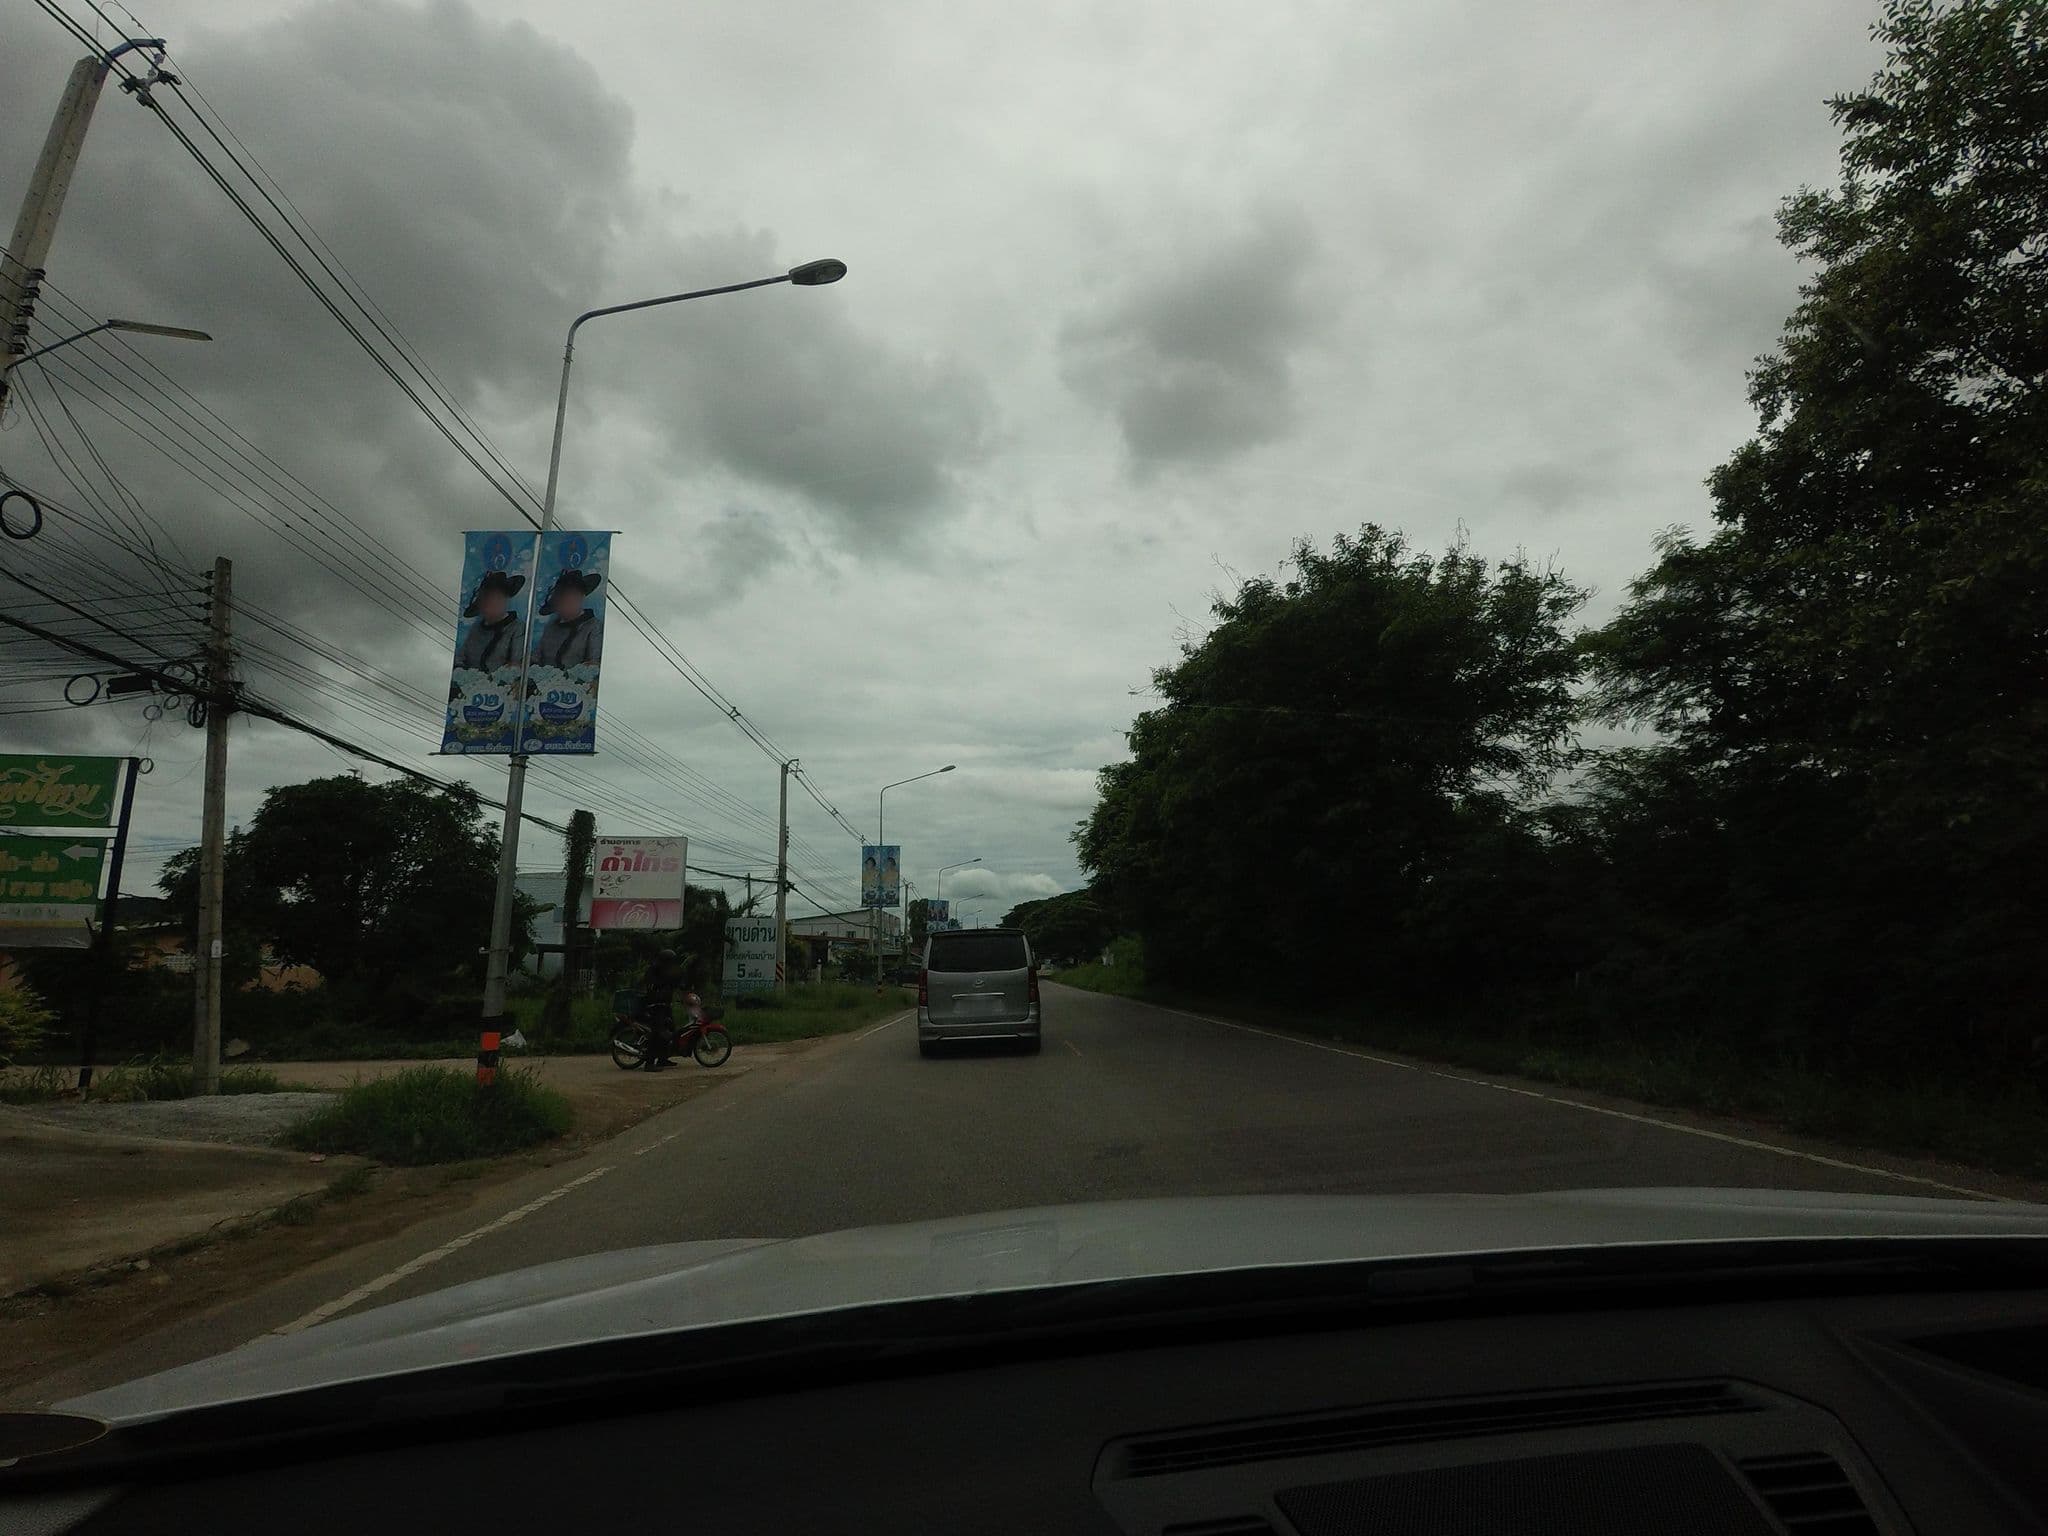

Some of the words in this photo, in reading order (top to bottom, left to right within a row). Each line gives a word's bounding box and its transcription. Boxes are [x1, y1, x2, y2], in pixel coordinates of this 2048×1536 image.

[726, 919, 777, 942] ขายด่วน
[737, 963, 746, 978] 5
